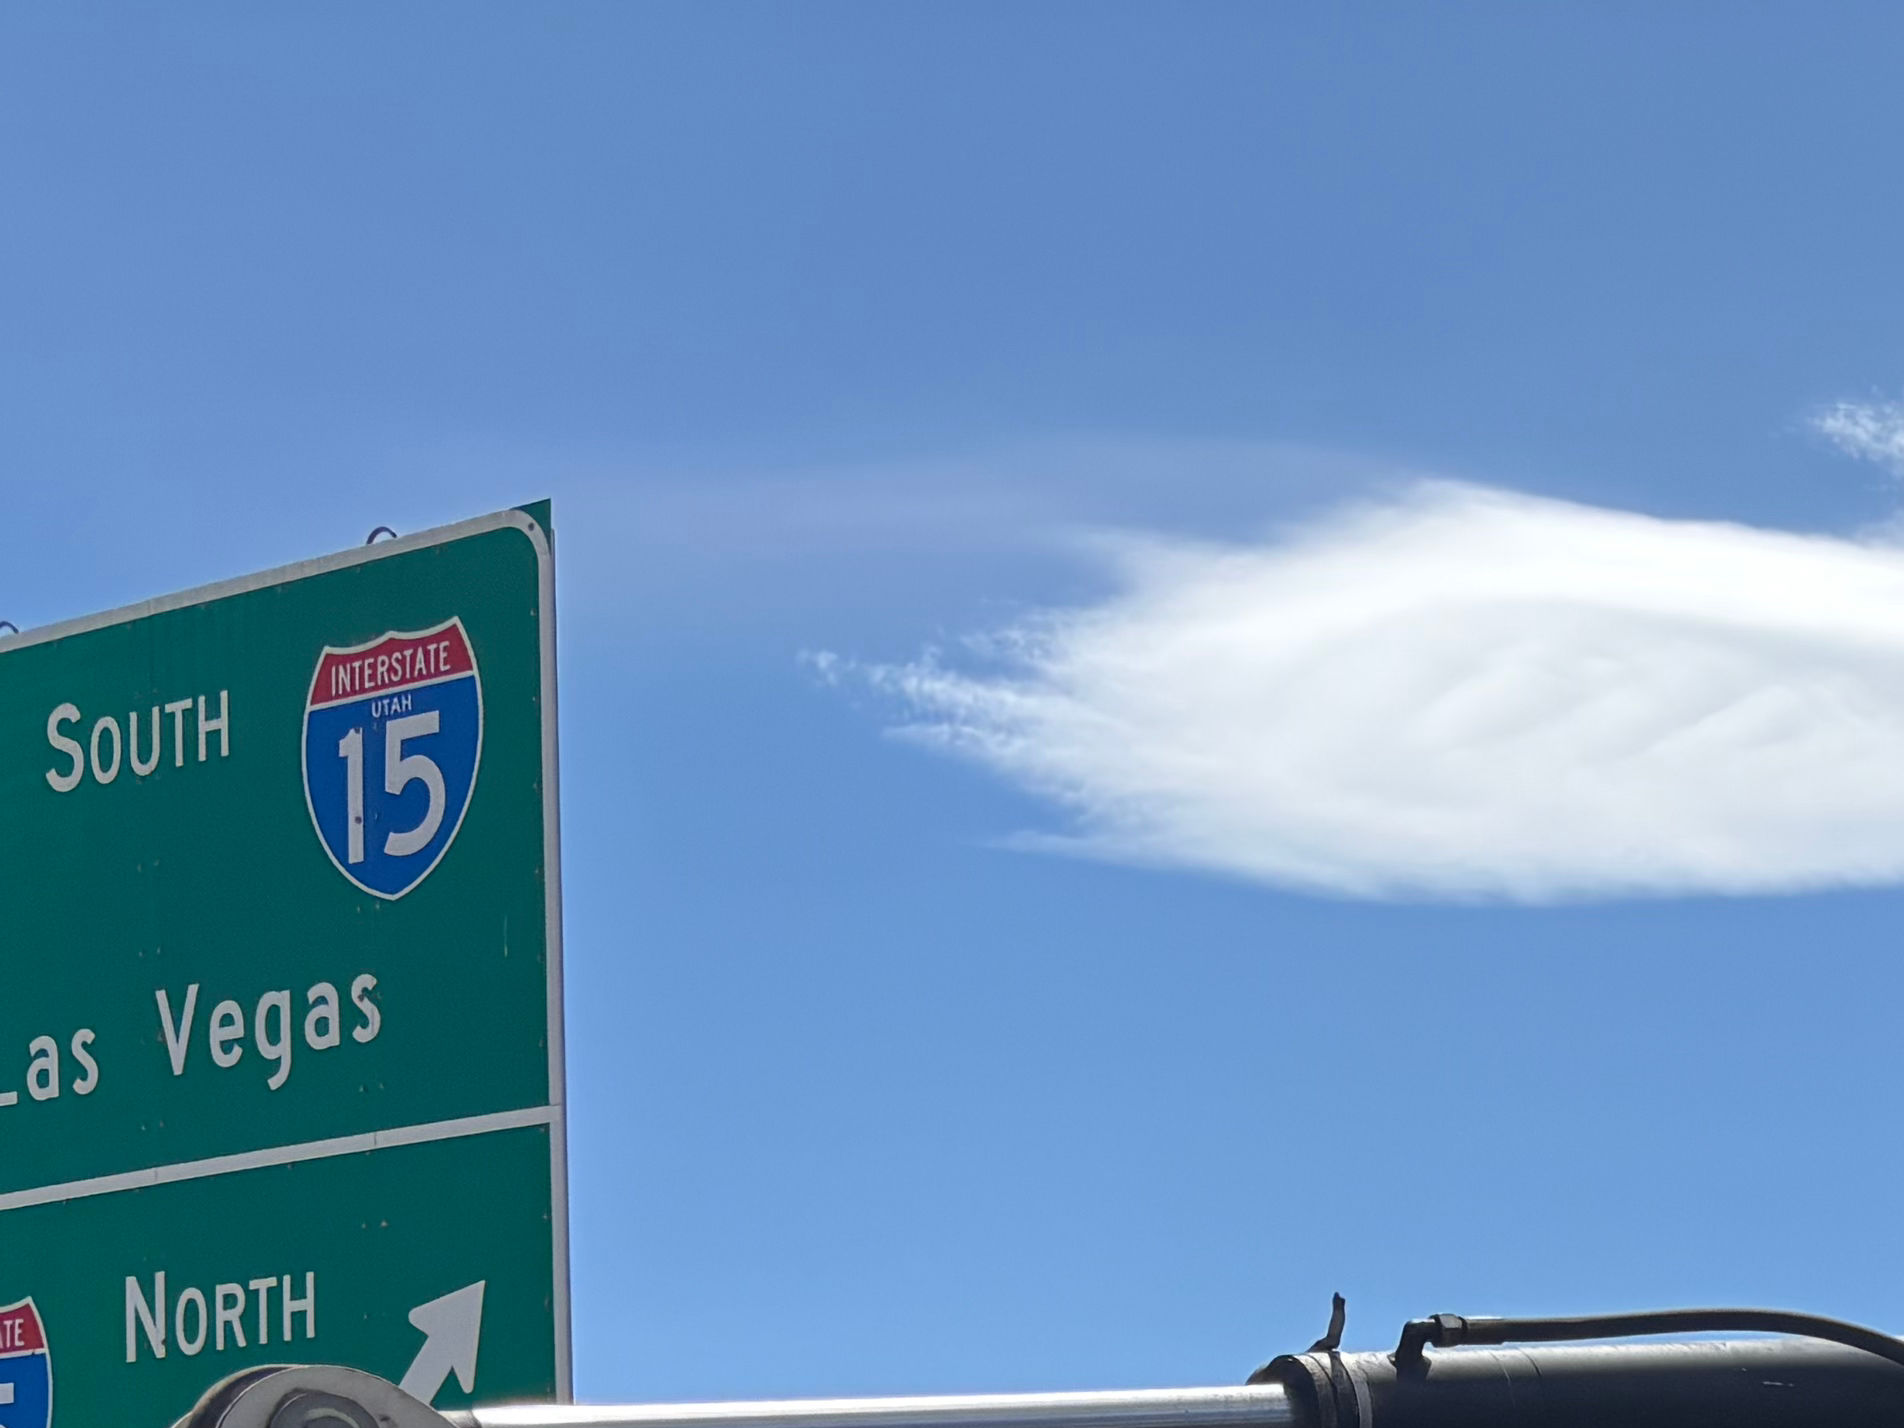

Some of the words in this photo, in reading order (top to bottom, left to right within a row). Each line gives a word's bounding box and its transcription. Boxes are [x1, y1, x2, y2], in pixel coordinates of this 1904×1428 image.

[331, 641, 452, 697] INTERSTATE
[372, 694, 413, 719] UTAH
[45, 689, 230, 793] SOUTH
[339, 710, 446, 865] 15
[0, 1027, 99, 1106] as
[155, 973, 382, 1091] Vegas
[125, 1271, 316, 1364] NORTH
